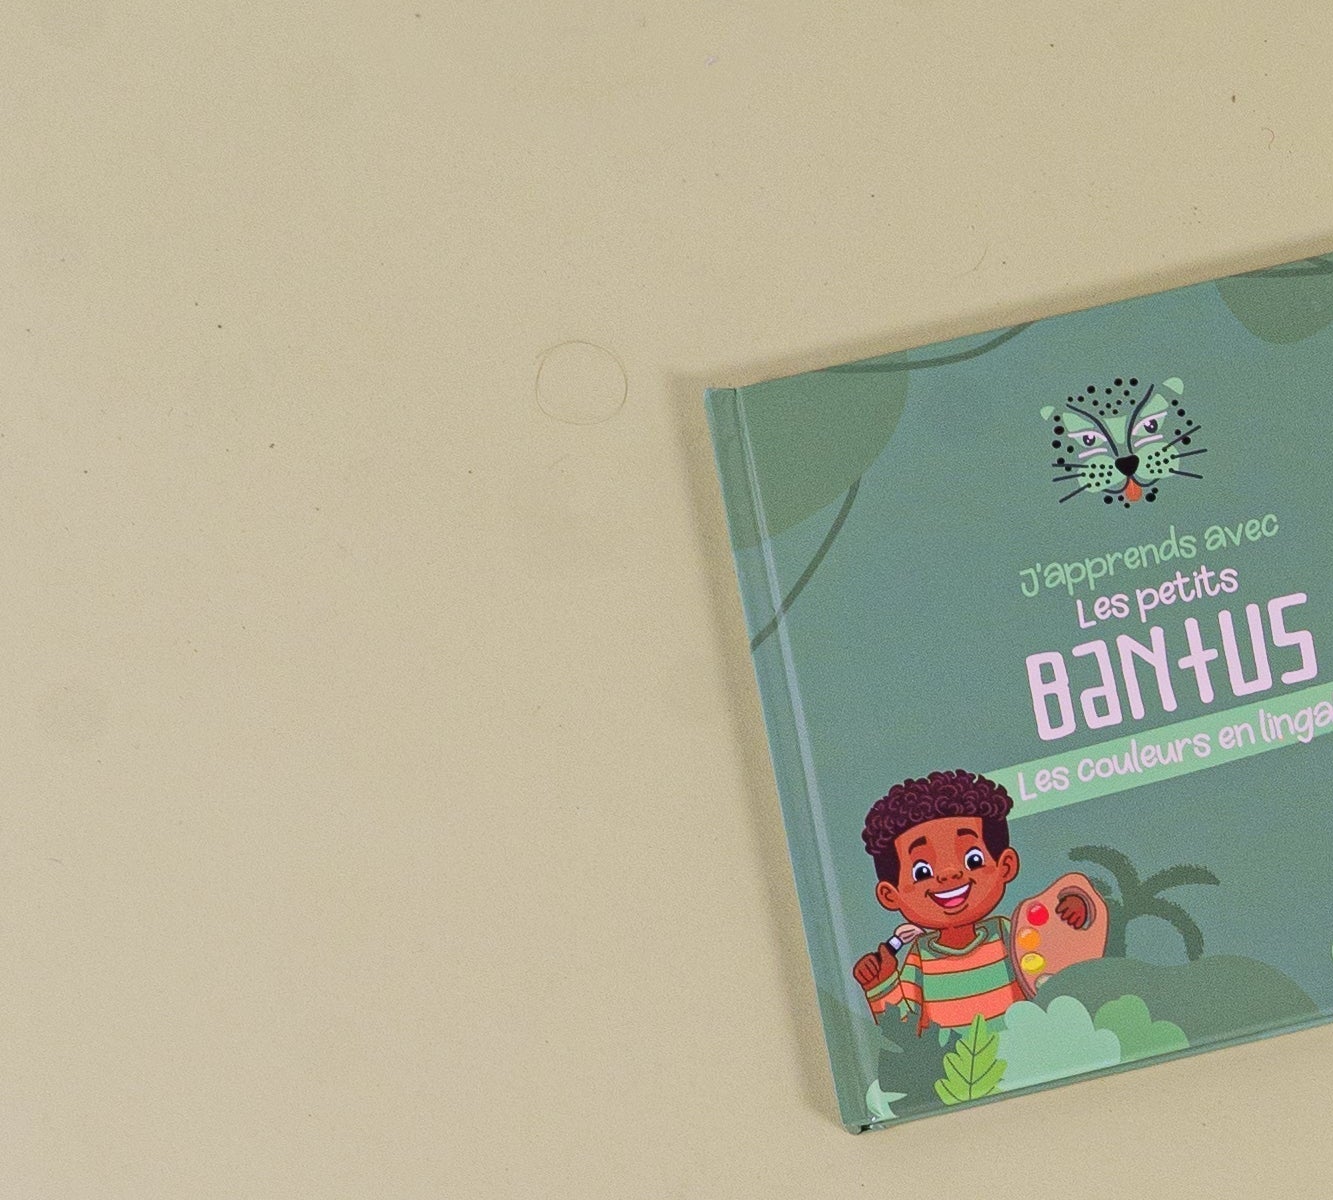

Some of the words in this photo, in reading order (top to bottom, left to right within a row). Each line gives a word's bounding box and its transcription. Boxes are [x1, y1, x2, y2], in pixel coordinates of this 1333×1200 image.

[1019, 527, 1198, 597] J'apprends
[1204, 513, 1279, 554] avec
[1076, 591, 1129, 629] Les
[1137, 565, 1239, 622] petits
[1017, 760, 1069, 802] Les
[1078, 729, 1212, 785] couleurs
[1218, 723, 1255, 750] en
